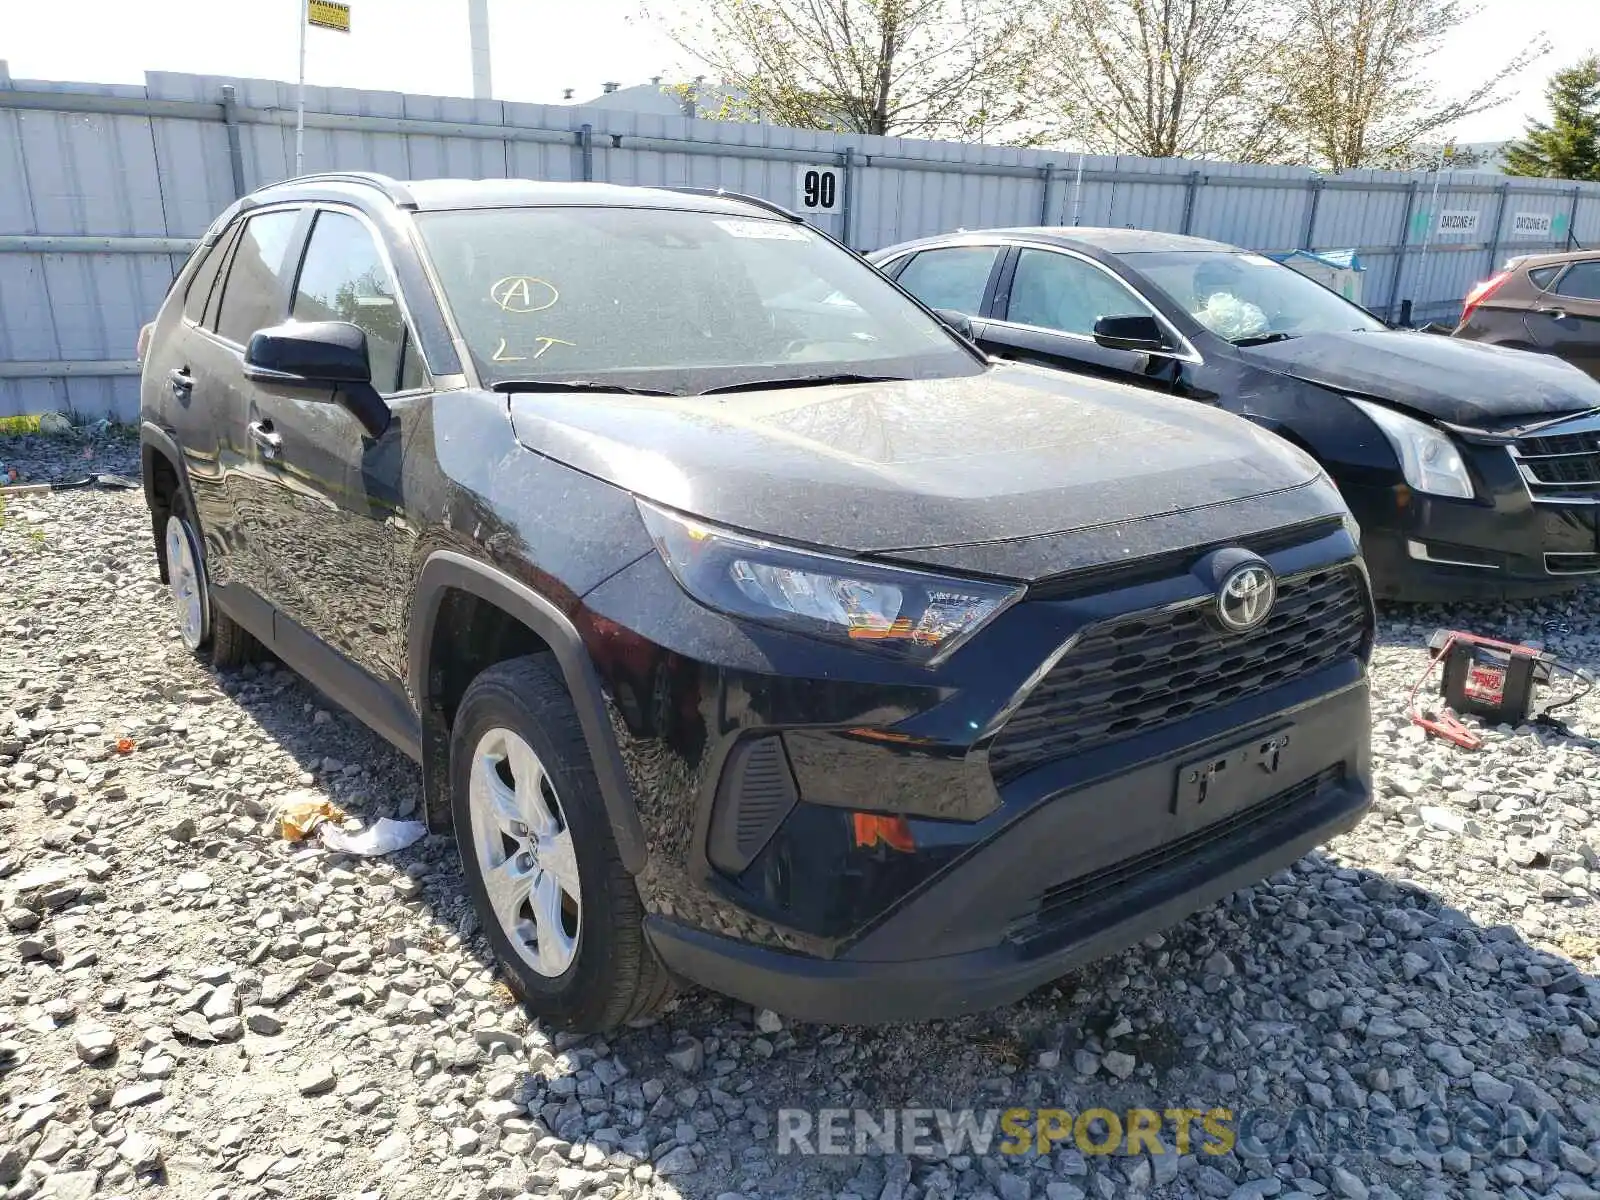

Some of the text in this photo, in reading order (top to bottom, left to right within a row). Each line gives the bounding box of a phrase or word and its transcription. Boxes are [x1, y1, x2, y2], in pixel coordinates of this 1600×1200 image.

[309, 0, 349, 12] WARNING
[804, 170, 836, 209] 90
[1441, 215, 1468, 229] DAYZONE
[1516, 216, 1541, 230] DAYZONE
[502, 279, 530, 310] A
